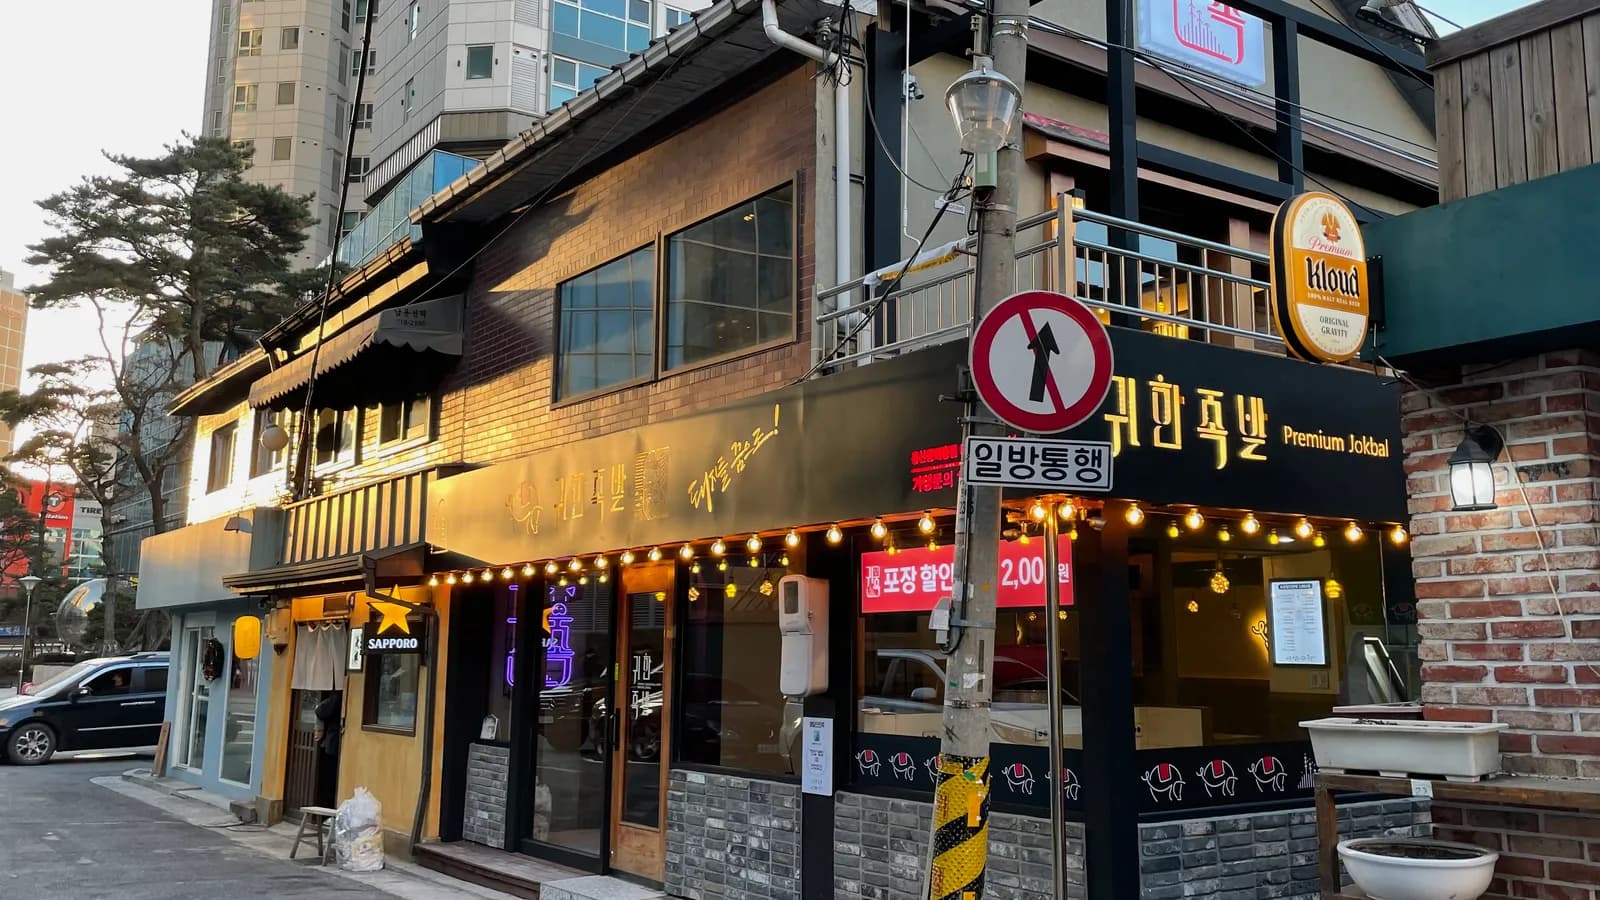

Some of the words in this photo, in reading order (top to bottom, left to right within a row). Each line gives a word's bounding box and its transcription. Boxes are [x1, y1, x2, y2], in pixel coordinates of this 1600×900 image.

[1319, 316, 1350, 328] ORIGINAL
[1321, 326, 1348, 338] GRAVITY
[1283, 426, 1345, 452] Premium
[1348, 434, 1390, 458] Jokbal
[975, 443, 1103, 483] 일방통행
[883, 565, 918, 594] 포장
[1001, 556, 1070, 588] 2,00원
[366, 637, 418, 650] SAPPORO
